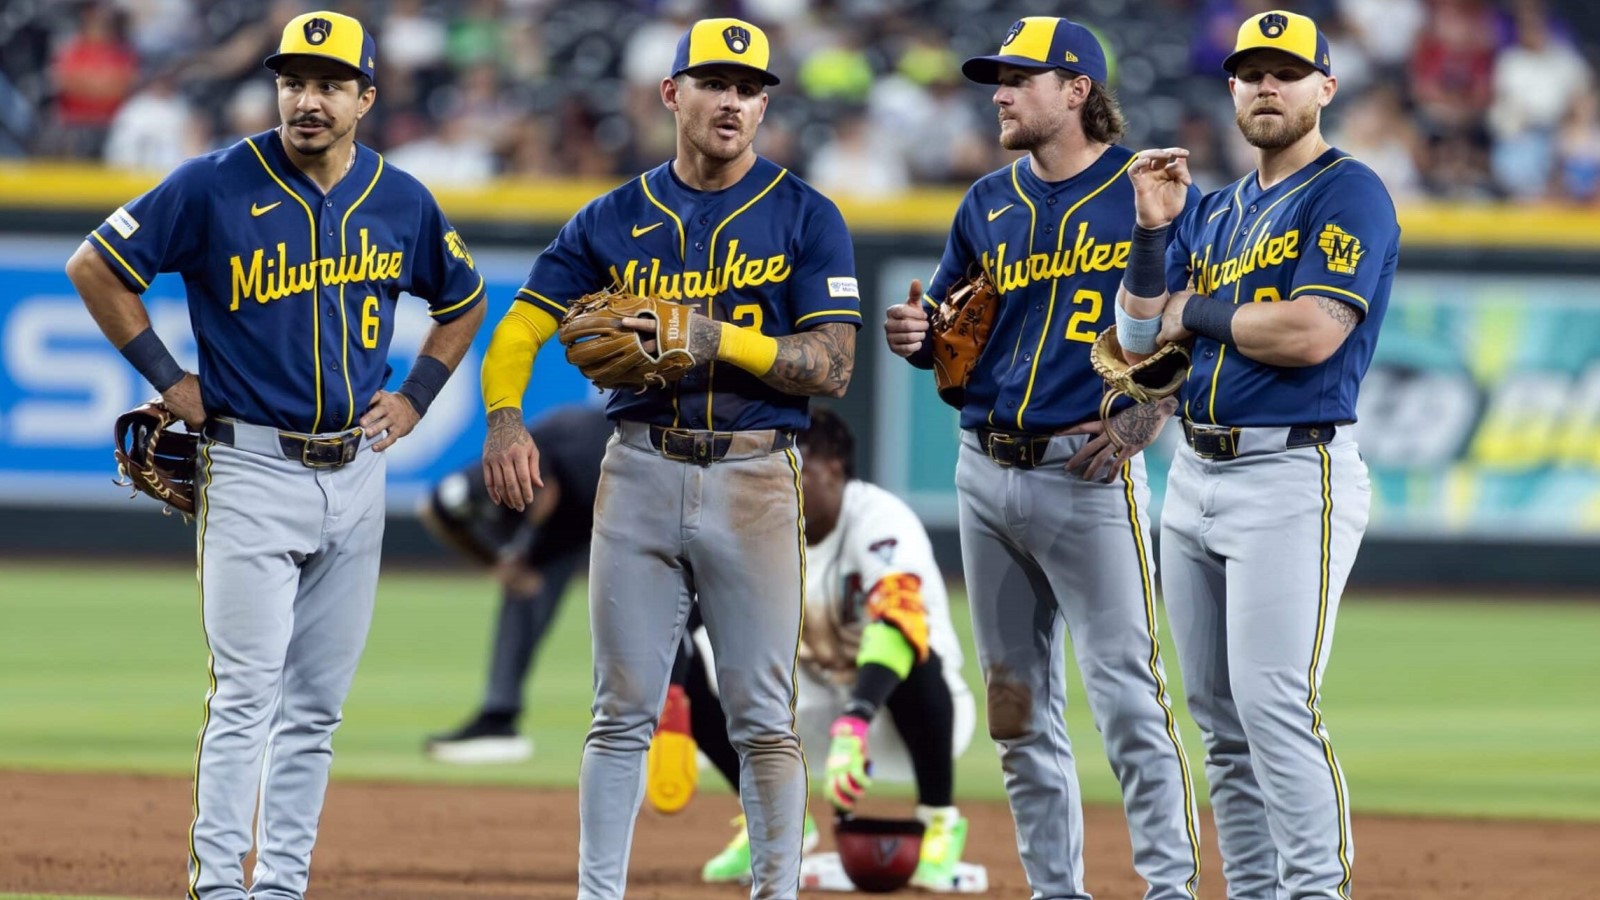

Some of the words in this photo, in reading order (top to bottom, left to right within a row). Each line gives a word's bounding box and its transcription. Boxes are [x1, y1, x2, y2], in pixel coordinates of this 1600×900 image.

[1330, 235, 1356, 264] M
[230, 228, 403, 311] Milwaukee
[361, 296, 380, 348] 6
[668, 306, 680, 341] Wilson
[1065, 289, 1102, 343] 2
[700, 442, 707, 457] 3
[1020, 446, 1027, 461] 2
